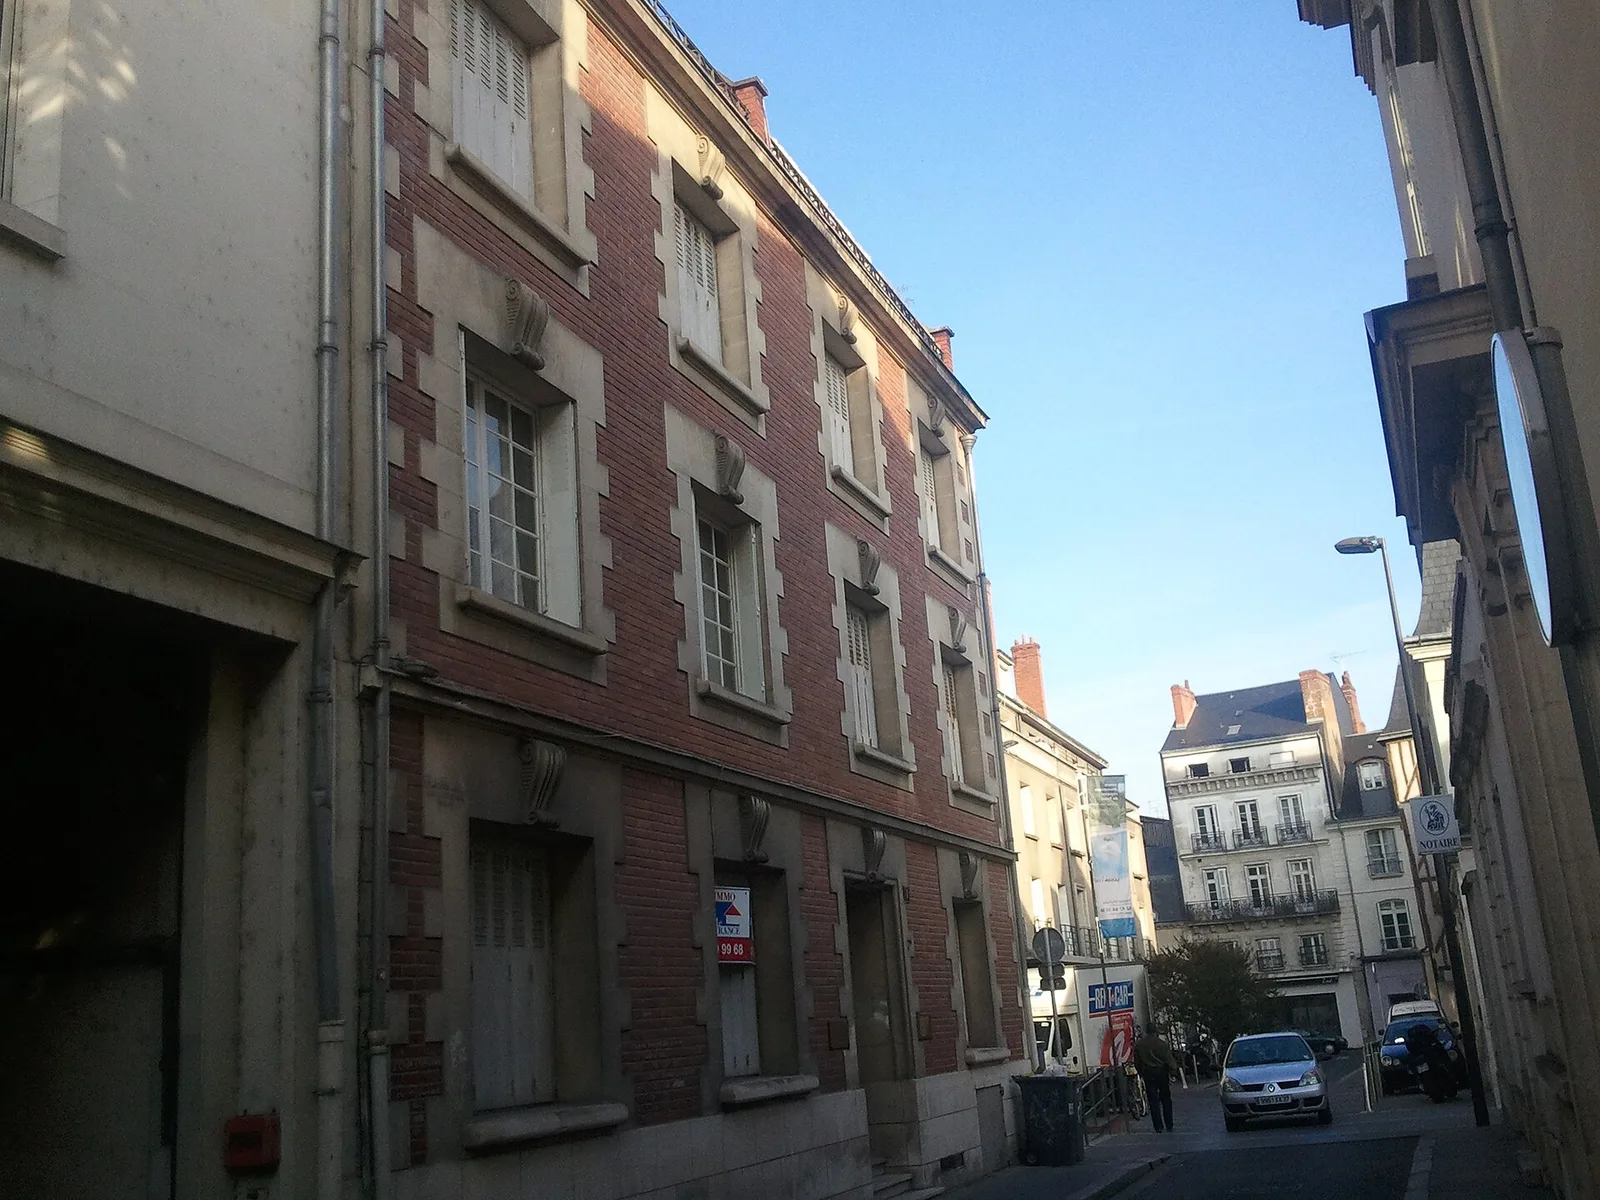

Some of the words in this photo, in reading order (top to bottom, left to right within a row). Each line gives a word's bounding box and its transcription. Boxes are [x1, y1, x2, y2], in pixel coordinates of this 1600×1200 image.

[1420, 838, 1457, 849] NOTAIRE
[717, 926, 740, 935] RANCE
[721, 943, 732, 955] 99
[733, 943, 744, 955] 68
[1114, 984, 1129, 1007] CAR
